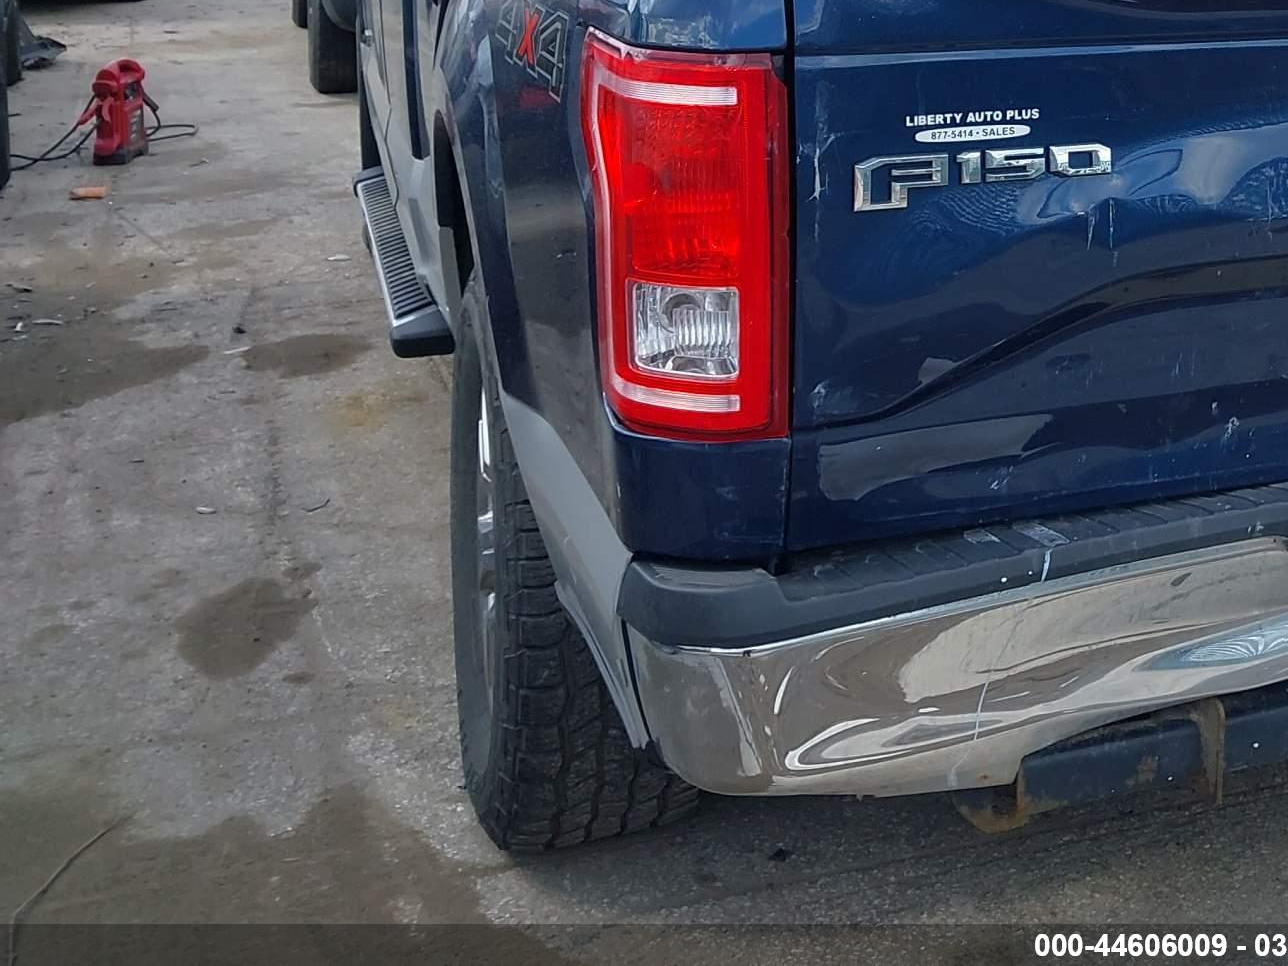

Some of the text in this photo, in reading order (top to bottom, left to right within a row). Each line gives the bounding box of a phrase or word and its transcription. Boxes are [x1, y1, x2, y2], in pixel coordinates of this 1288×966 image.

[905, 108, 1040, 127] LIBERTY AUTO PLUS
[930, 127, 1016, 140] 877-5414 SALES
